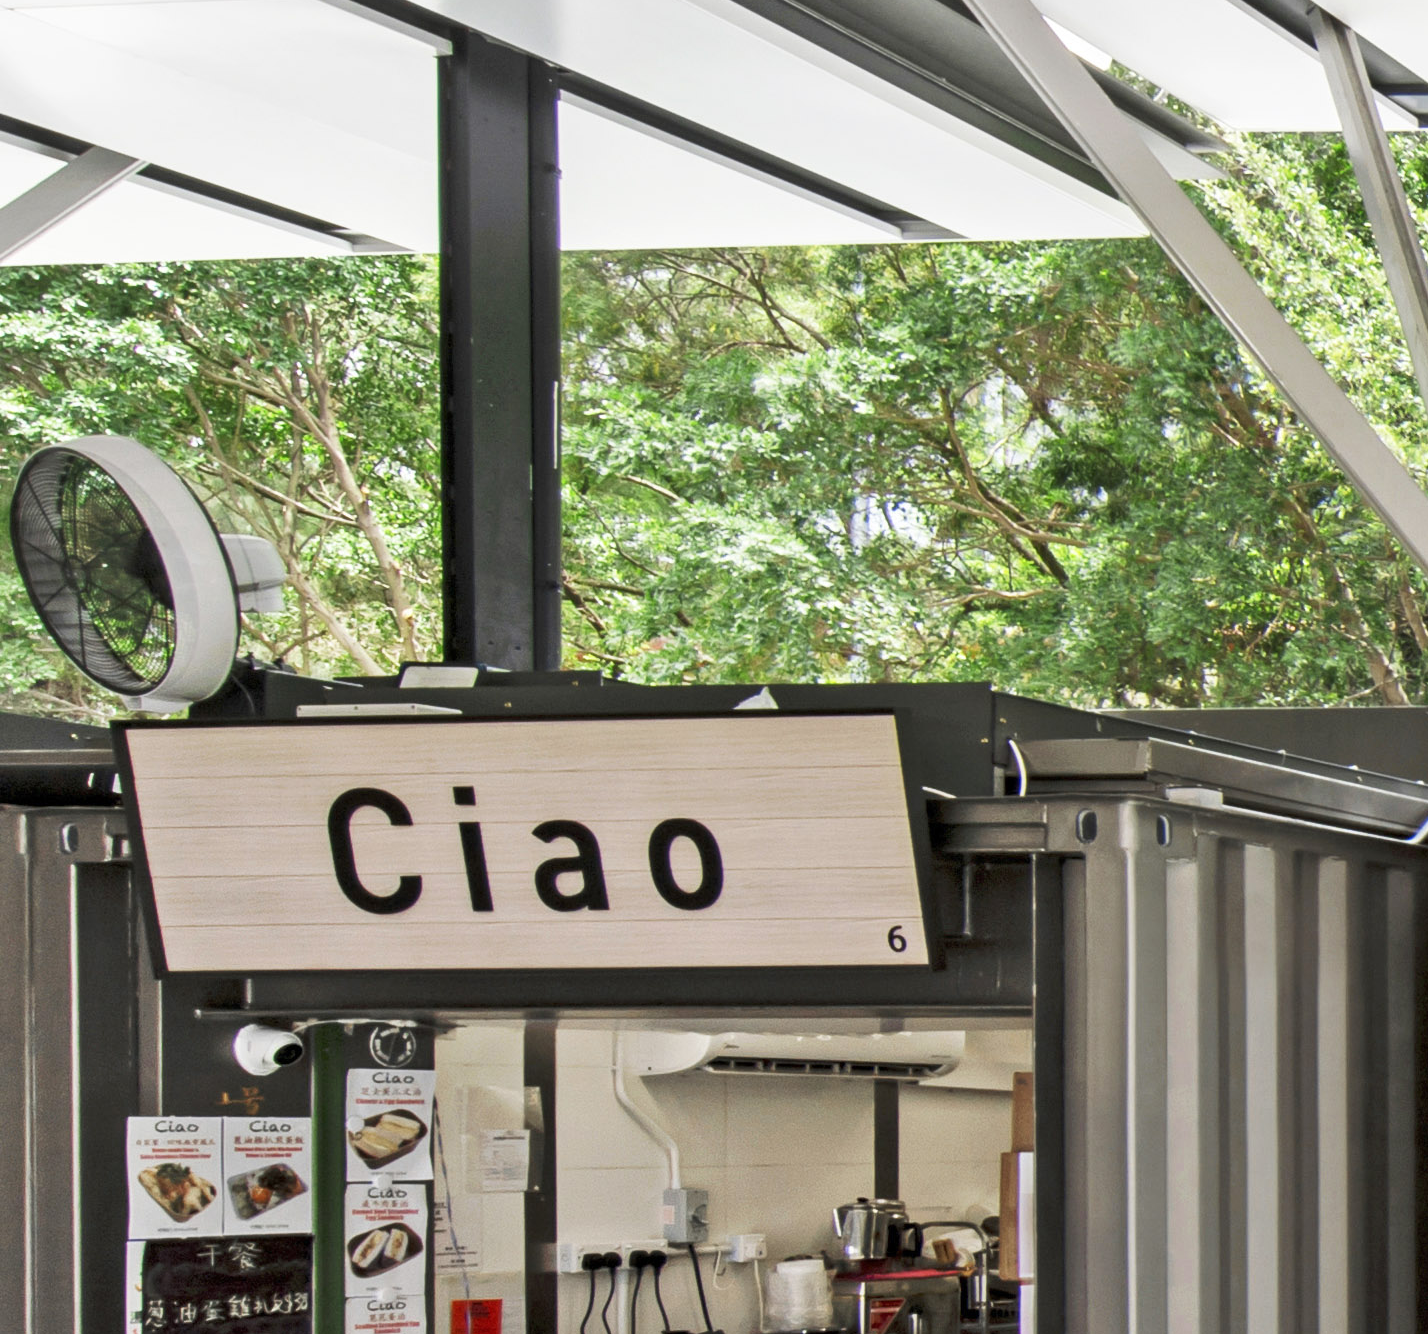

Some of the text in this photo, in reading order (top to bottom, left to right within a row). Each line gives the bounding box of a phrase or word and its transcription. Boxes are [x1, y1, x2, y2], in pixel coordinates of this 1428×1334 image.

[327, 786, 724, 915] Ciao
[887, 925, 908, 953] 6
[372, 1072, 415, 1084] Ciao
[154, 1120, 200, 1133] Ciao
[249, 1120, 292, 1133] Ciao
